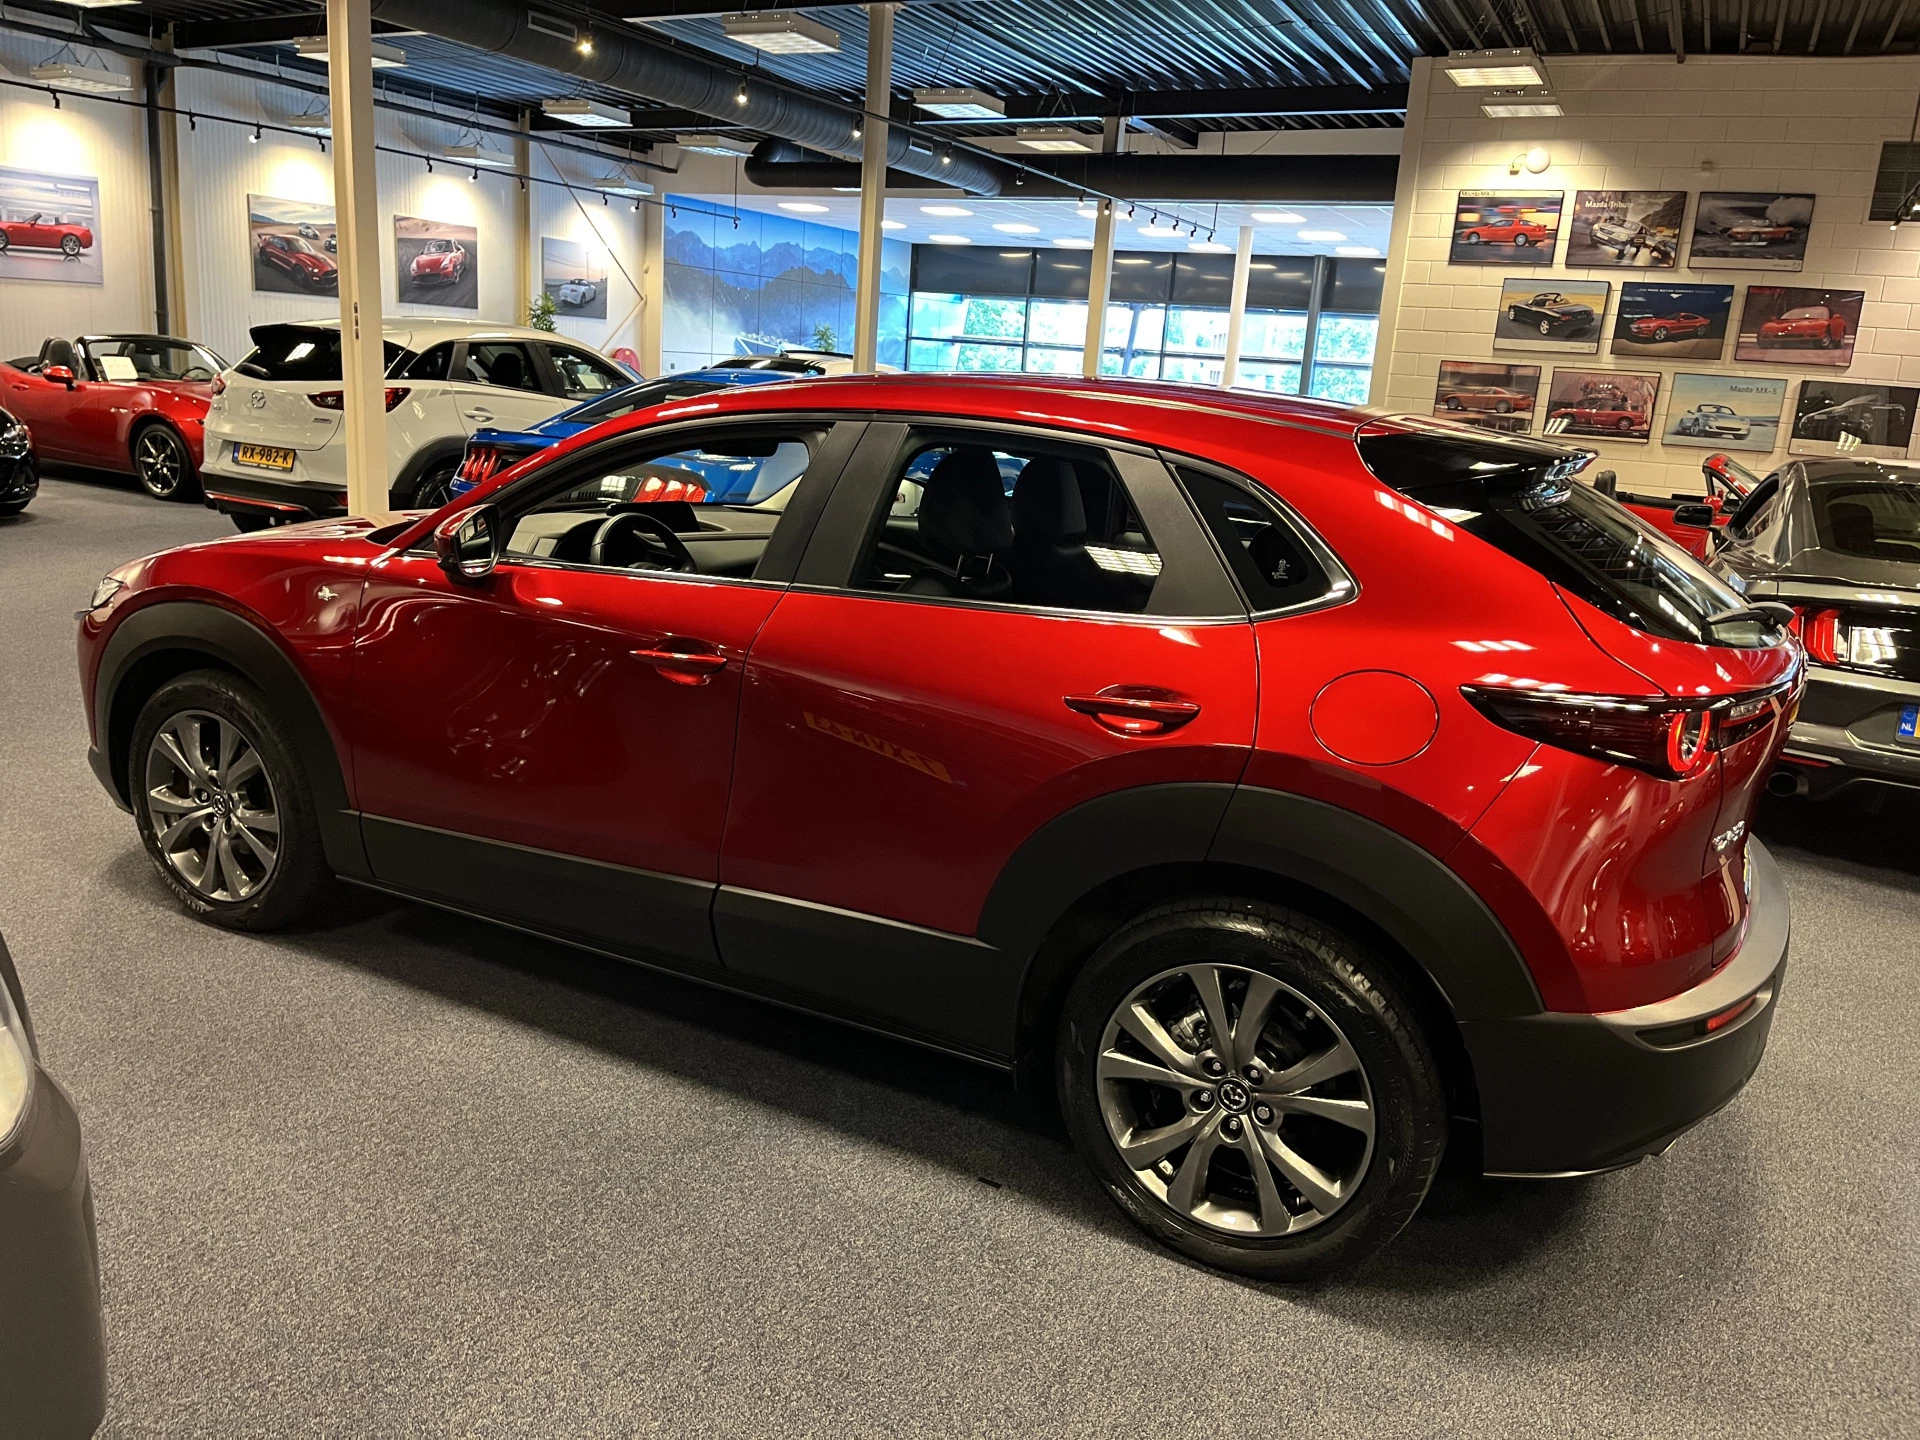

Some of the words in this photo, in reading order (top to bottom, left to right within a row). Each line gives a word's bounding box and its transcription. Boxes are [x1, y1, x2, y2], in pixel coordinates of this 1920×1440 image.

[1584, 200, 1608, 208] Mazda
[1729, 385, 1754, 394] Mazda
[1755, 386, 1778, 395] MX-5
[241, 446, 290, 465] RX-982-K
[1901, 722, 1913, 731] NL
